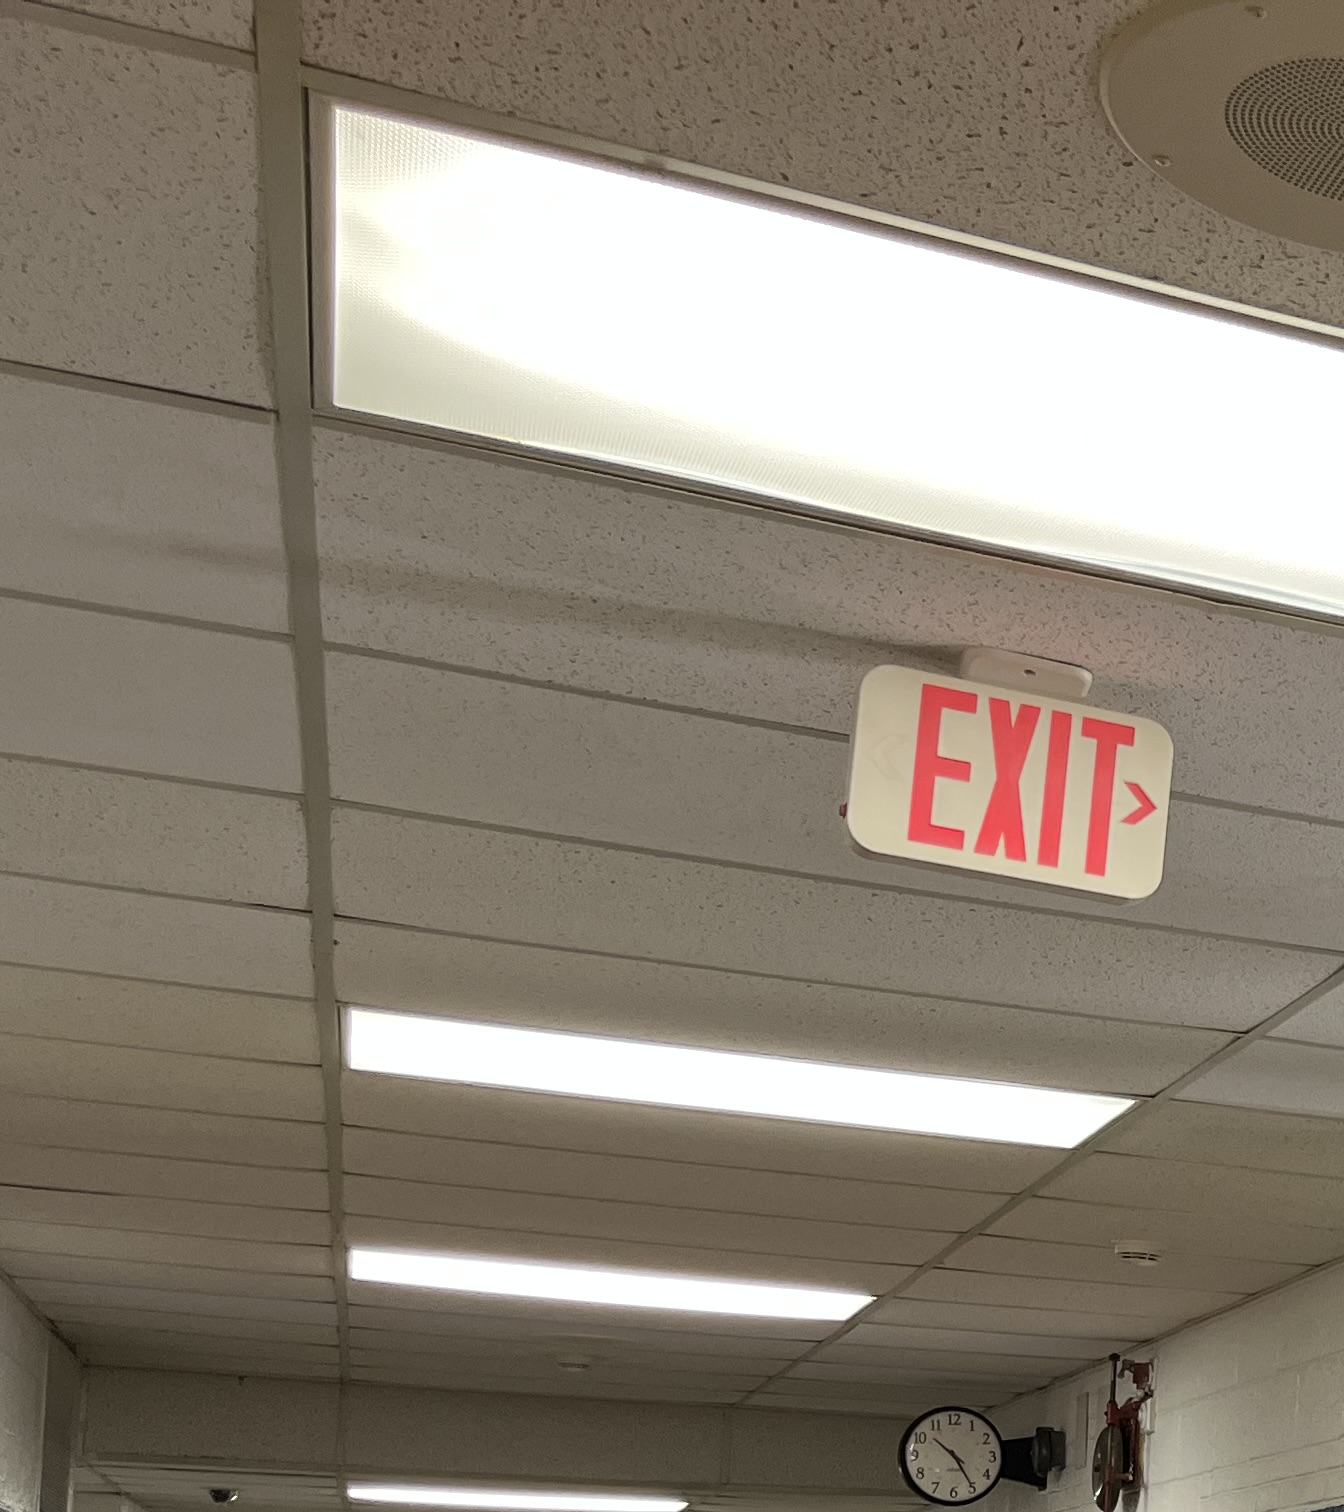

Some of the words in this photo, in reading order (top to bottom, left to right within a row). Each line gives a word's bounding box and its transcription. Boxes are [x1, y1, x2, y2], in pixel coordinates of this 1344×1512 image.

[907, 684, 1136, 877] EXIT
[931, 1419, 941, 1432] 11
[947, 1413, 961, 1426] 12
[969, 1420, 975, 1432] 1
[914, 1431, 927, 1444] 10
[982, 1432, 991, 1445] 2
[911, 1450, 919, 1462] 9
[988, 1450, 997, 1463] 3
[916, 1467, 925, 1480] 8
[982, 1468, 991, 1480] 4
[931, 1481, 940, 1494] 7
[949, 1486, 959, 1499] 6
[968, 1481, 977, 1494] 5
